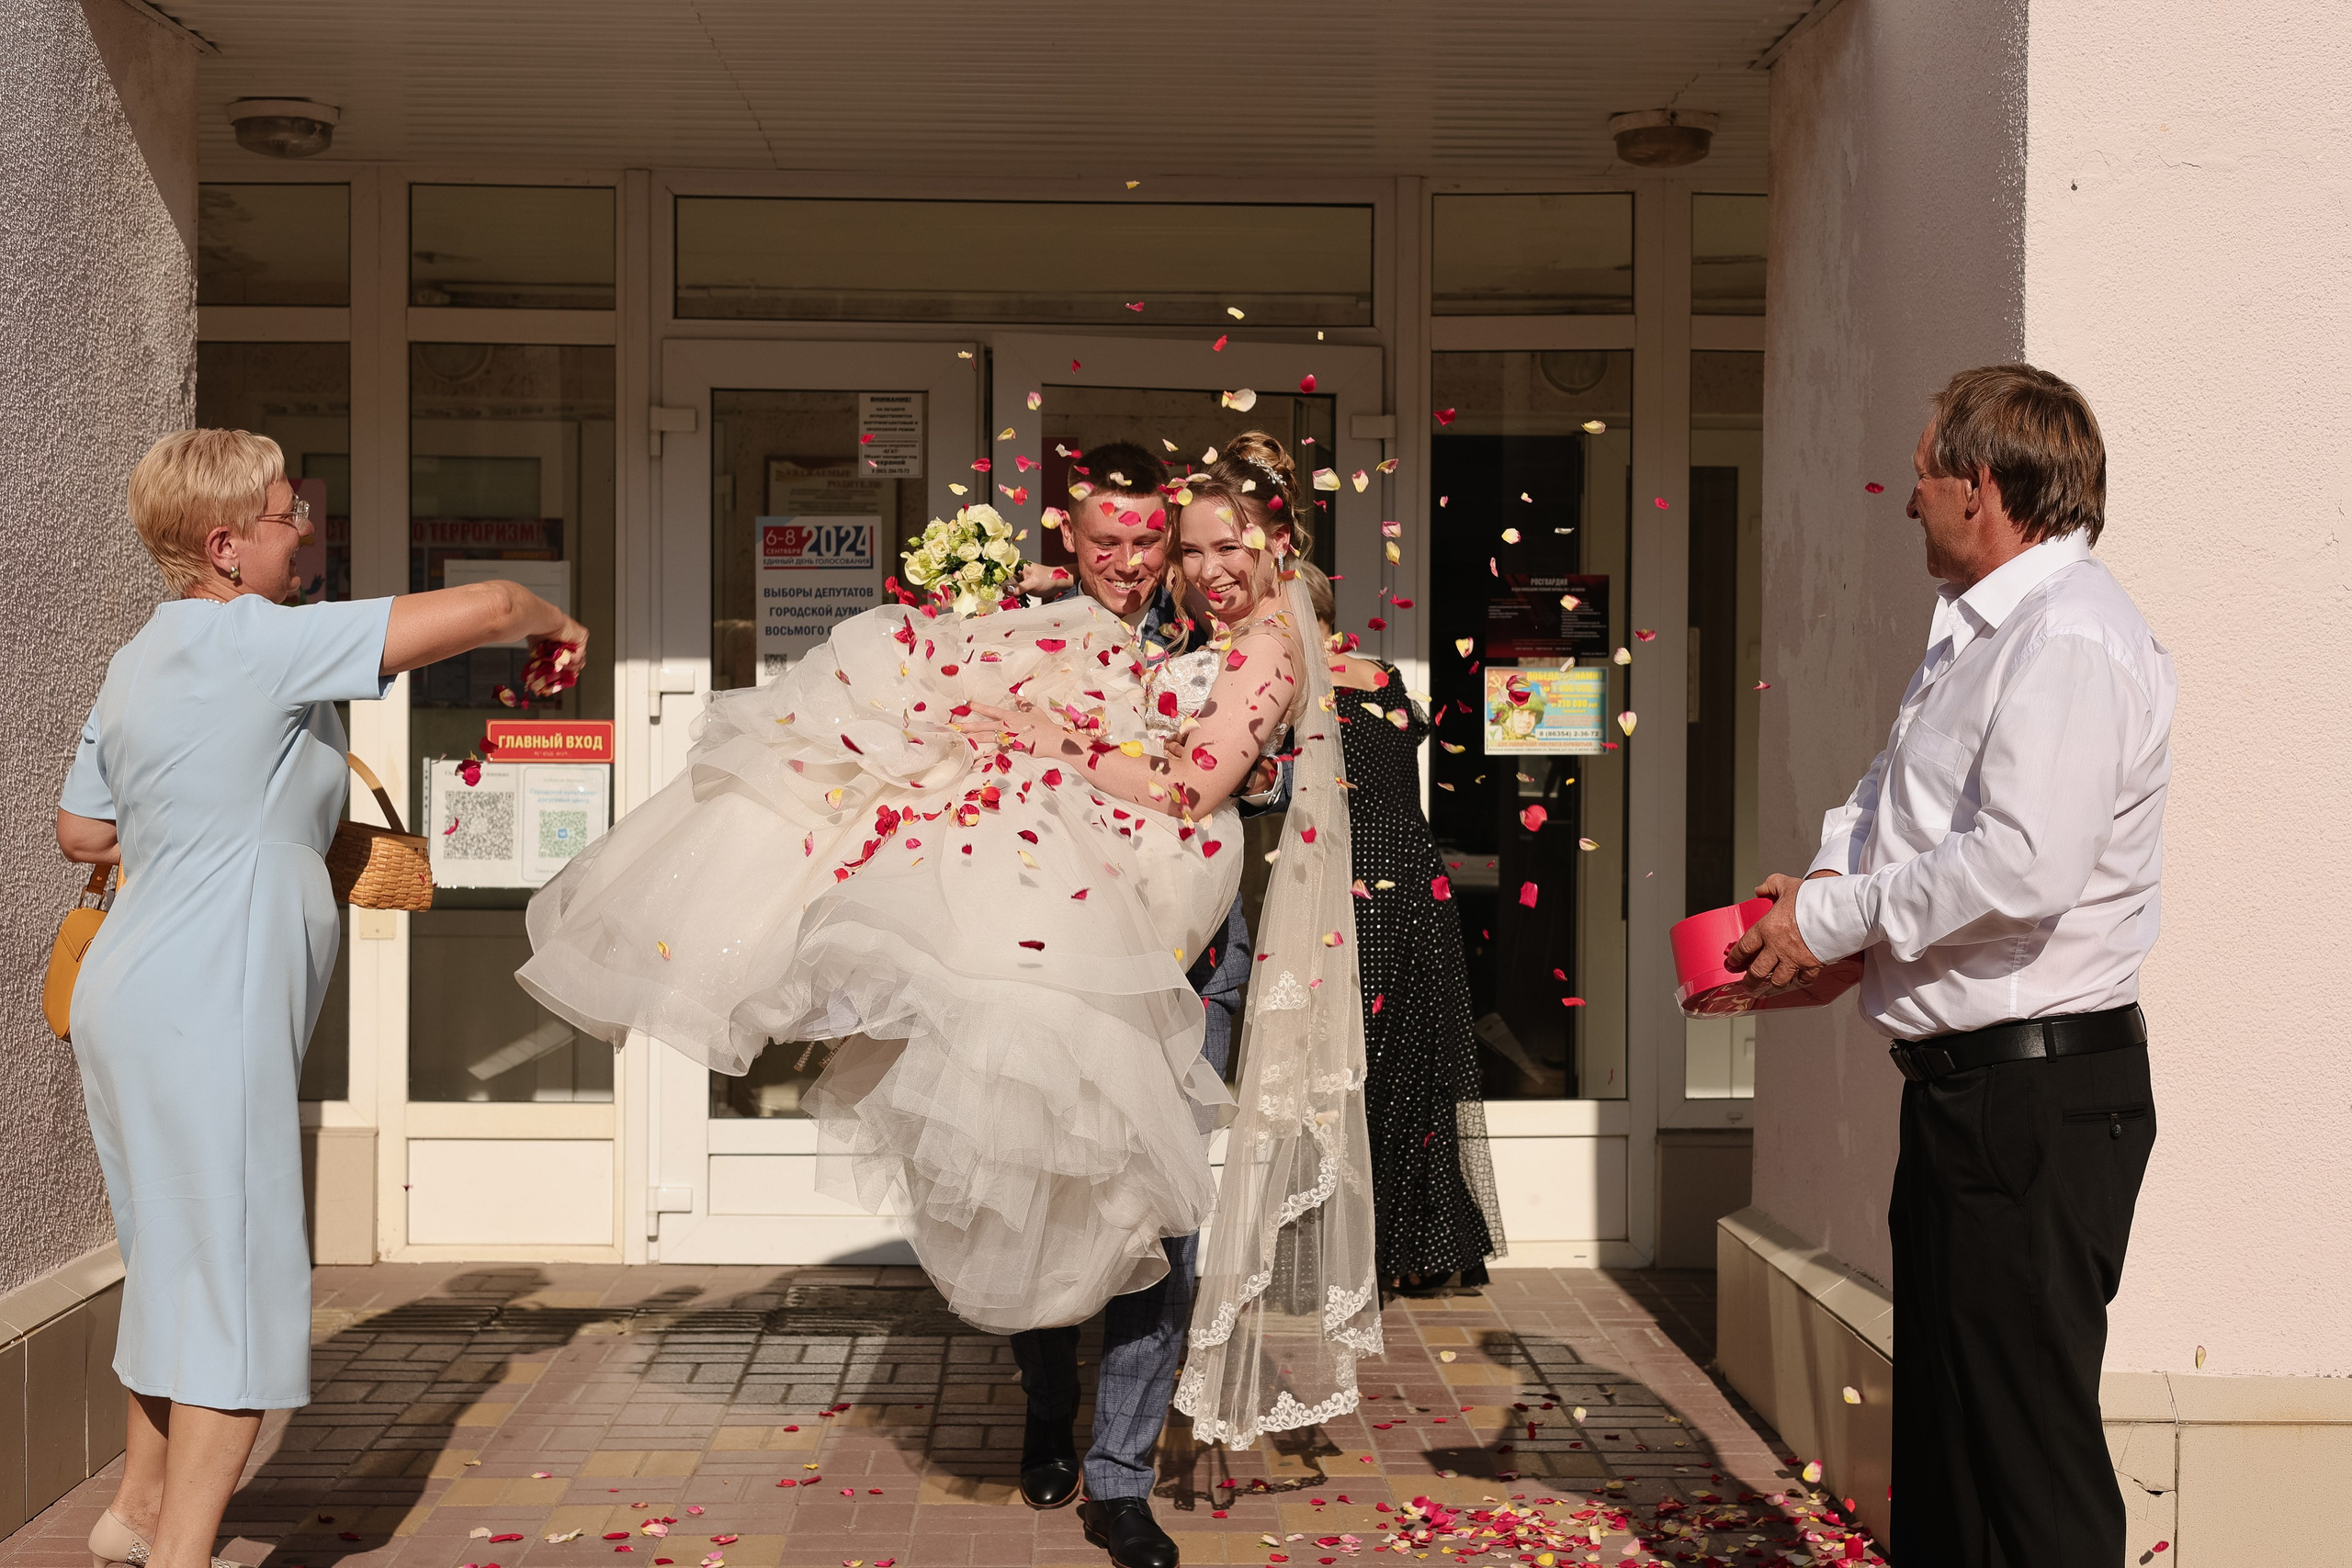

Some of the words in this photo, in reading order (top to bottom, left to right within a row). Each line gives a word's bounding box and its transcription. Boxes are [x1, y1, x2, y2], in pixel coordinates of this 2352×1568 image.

[429, 522, 541, 544] ТЕРРОРИЗМ!
[765, 529, 797, 546] 6-8
[801, 526, 868, 557] 2024
[765, 547, 802, 556] СЕНТЯБРЯ
[763, 557, 795, 566] ЕДИНЫЙ
[795, 558, 814, 566] ДЕНЬ
[763, 588, 813, 598] ВЫБОРЫ
[814, 588, 875, 600] ДЕПУТАТОВ
[769, 604, 833, 618] ГОРОДСКОЙ
[764, 626, 825, 637] ВОСЬМОГО
[497, 732, 564, 749] ГЛАВНЫЙ
[565, 735, 604, 751] ВХОД
